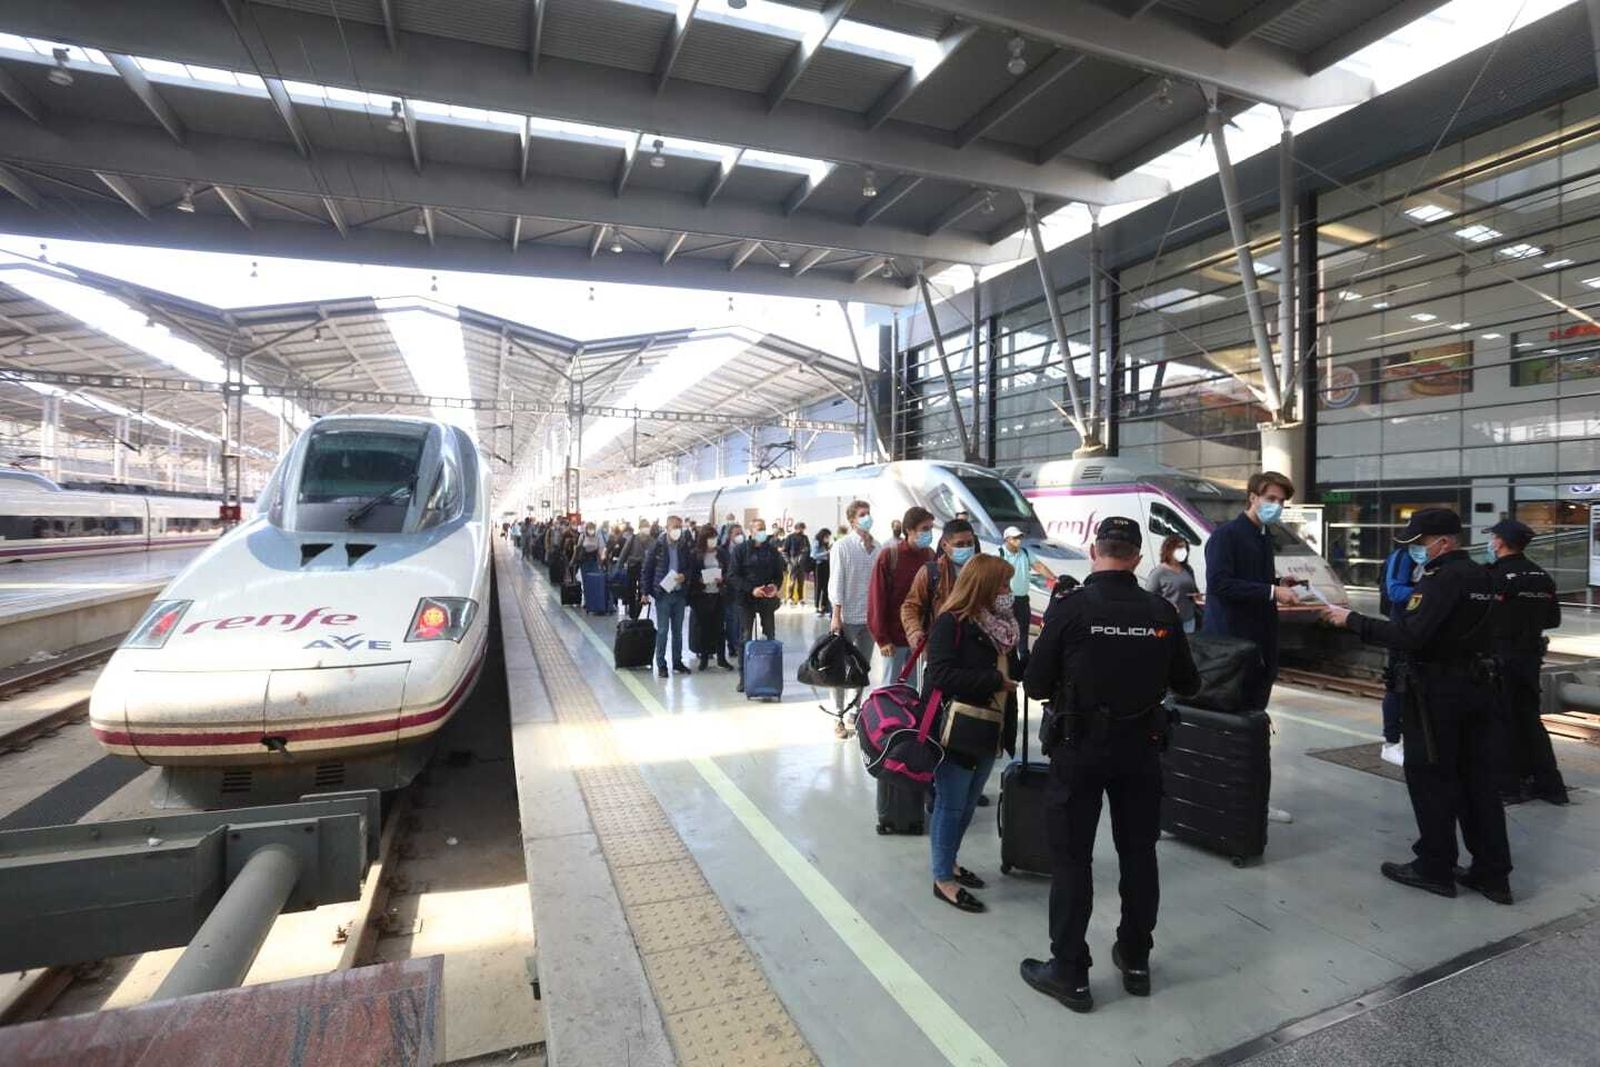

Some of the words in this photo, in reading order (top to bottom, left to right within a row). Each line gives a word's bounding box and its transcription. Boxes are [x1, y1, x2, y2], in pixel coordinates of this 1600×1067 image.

[182, 606, 358, 635] renfe
[1090, 625, 1157, 636] POLICIA
[302, 633, 392, 651] AVE
